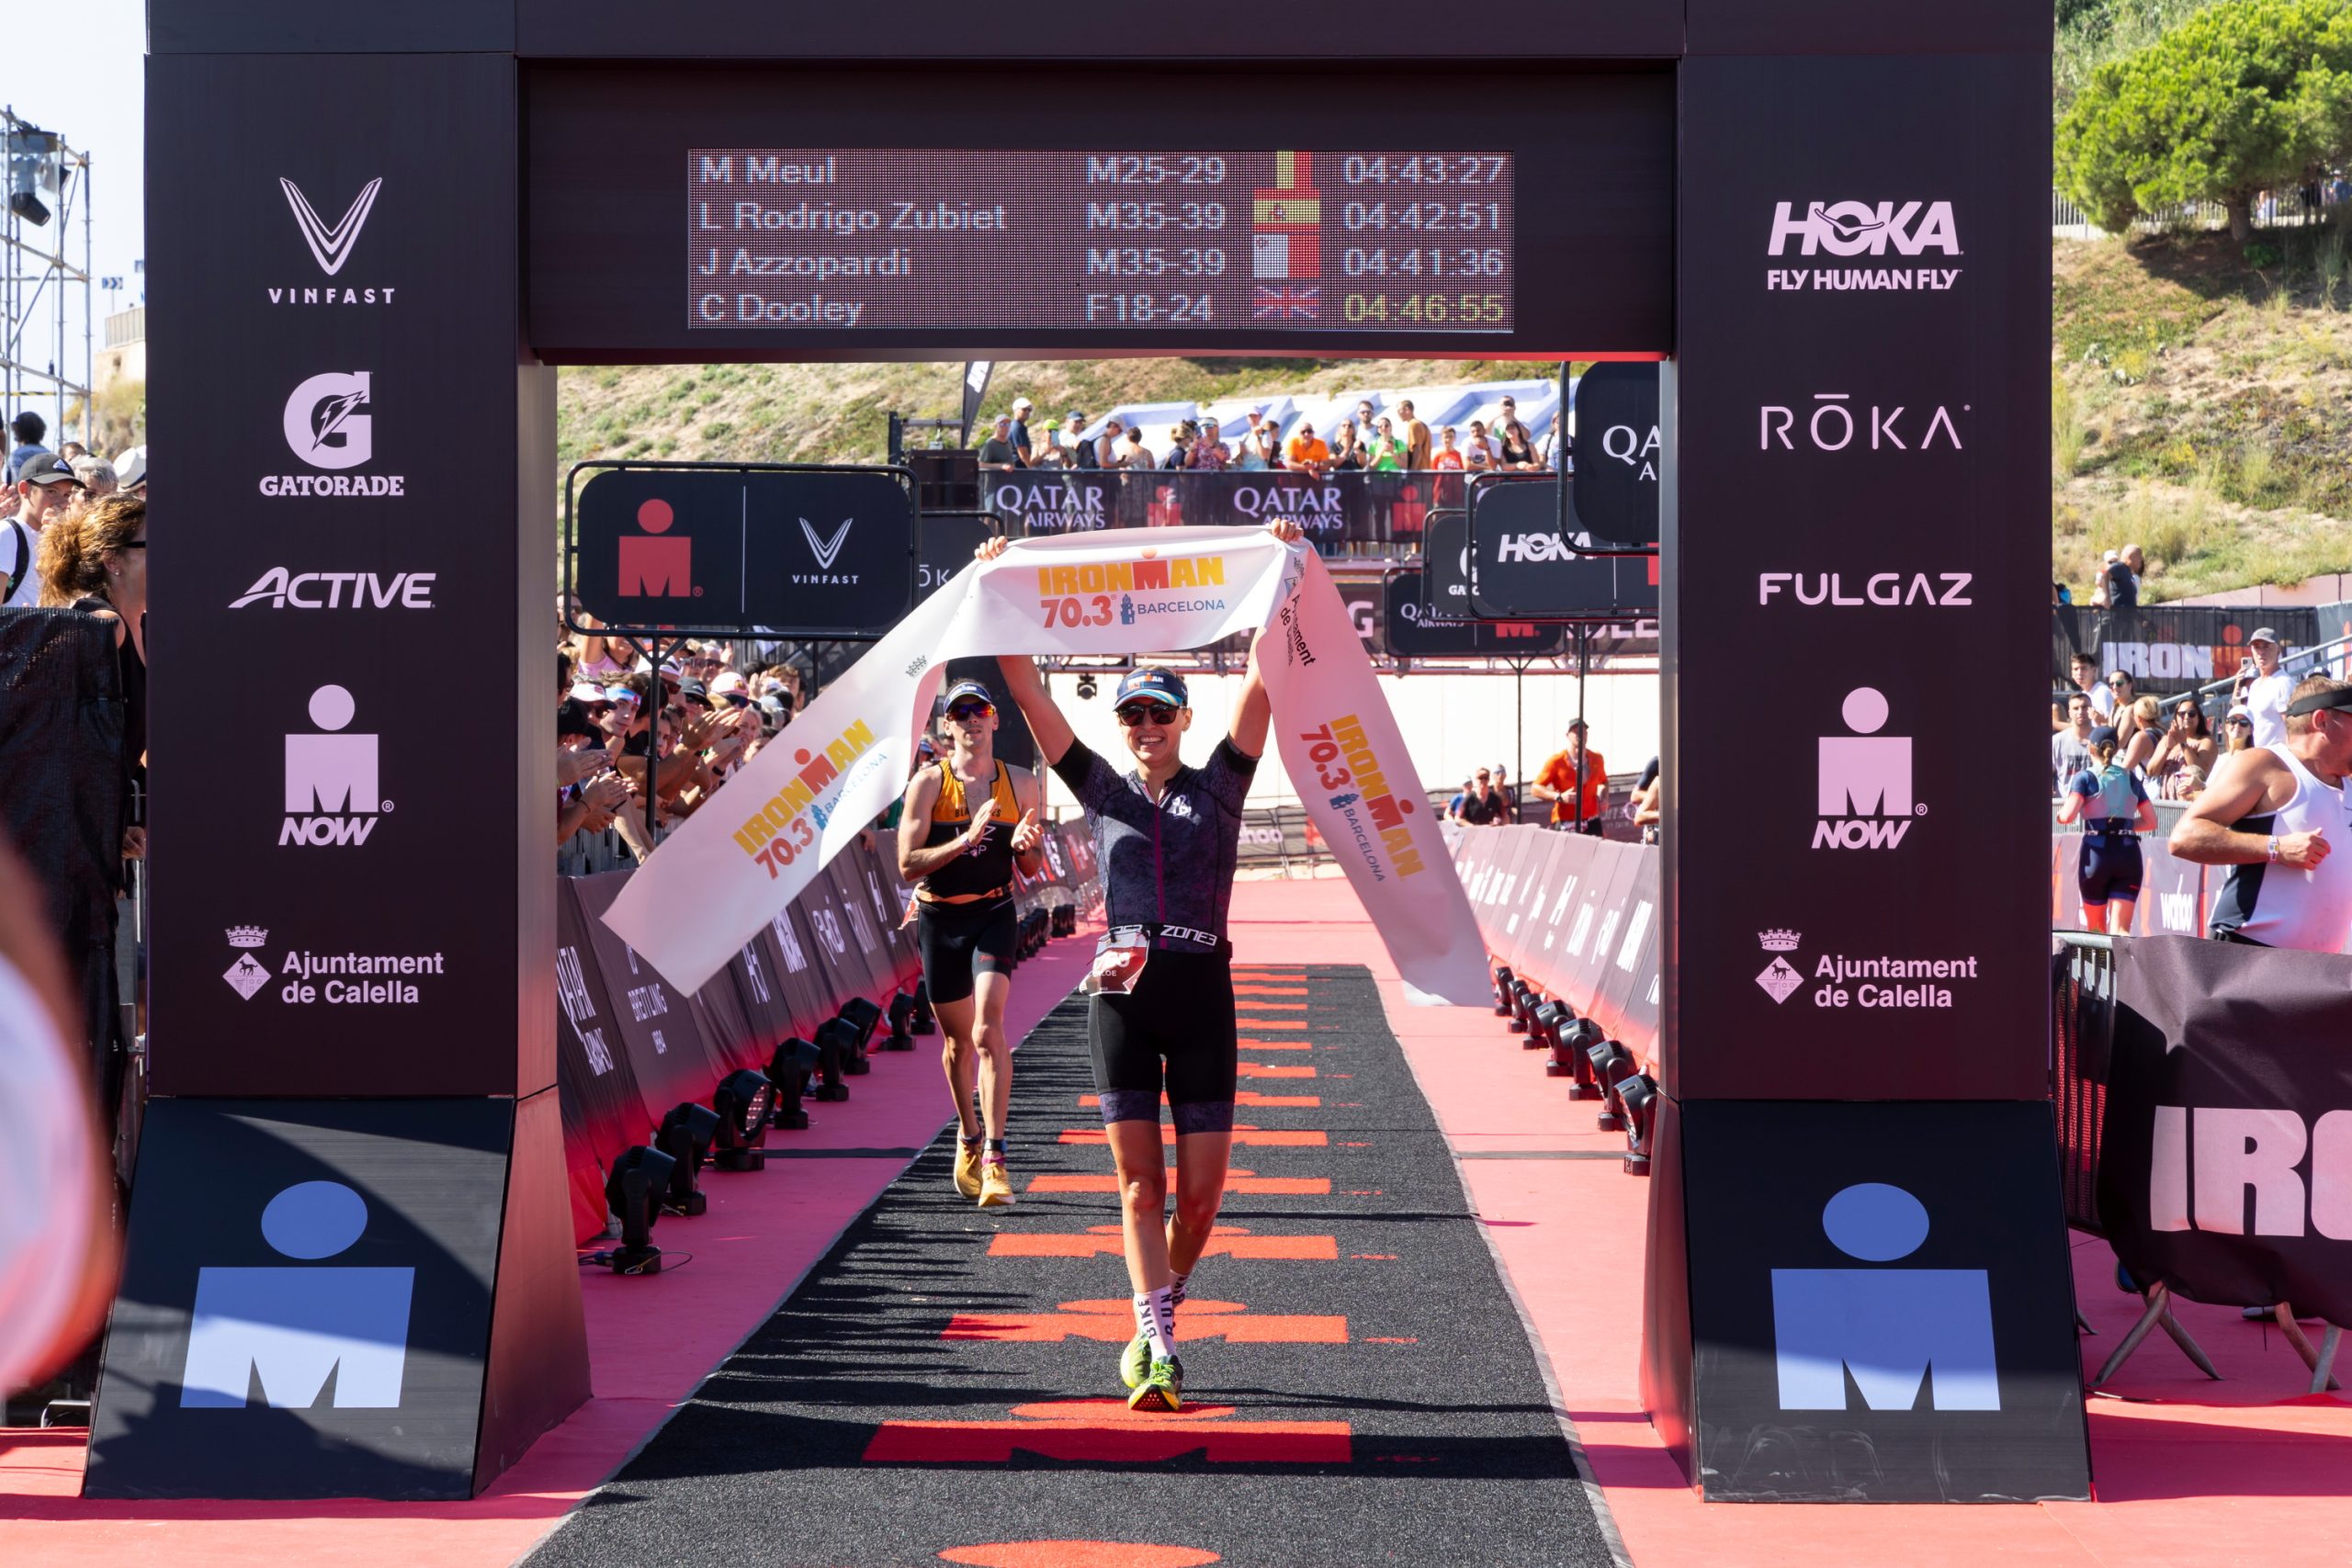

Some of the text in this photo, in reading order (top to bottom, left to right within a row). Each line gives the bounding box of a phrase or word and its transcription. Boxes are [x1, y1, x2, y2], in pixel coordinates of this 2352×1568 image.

[699, 156, 1506, 186] M Meul M25-29 04:43:27
[699, 202, 1504, 236] L Rodrigo Zubiet M35-39 04:42:51
[1768, 200, 1961, 256] HOKA
[698, 248, 1505, 283] J Azzopardi M35-39 04:41:36
[1767, 269, 1960, 290] FLY HUMAN FLY
[267, 288, 396, 304] VINFAST
[698, 294, 1505, 327] C Dooley F18-24 04:46:55
[259, 475, 405, 496] GATORADE
[996, 484, 1104, 516] QATAR
[1234, 486, 1342, 518] QATAR
[1023, 512, 1105, 529] AIRWAYS
[1498, 531, 1594, 563] HOKA
[228, 566, 436, 609] ACTIVE
[792, 574, 860, 585] VINFAST
[1038, 547, 1225, 596] IRONMAN
[1759, 572, 1973, 606] FULGAZ
[1040, 593, 1226, 629] 70.3 BARCELONA
[732, 718, 876, 857] IRONMAN
[1299, 724, 1387, 883] 70.3 BARCELONA
[1329, 714, 1426, 882] IRONMAN
[278, 817, 379, 846] NOW
[753, 752, 888, 881] 70.3 BARCELONA
[1811, 820, 1912, 849] NOW
[281, 952, 444, 979] Ajuntament
[1815, 954, 1978, 983] Ajuntament
[281, 980, 420, 1004] de Calella
[1815, 984, 1952, 1008] de Calella
[1138, 1299, 1158, 1339] BIKE
